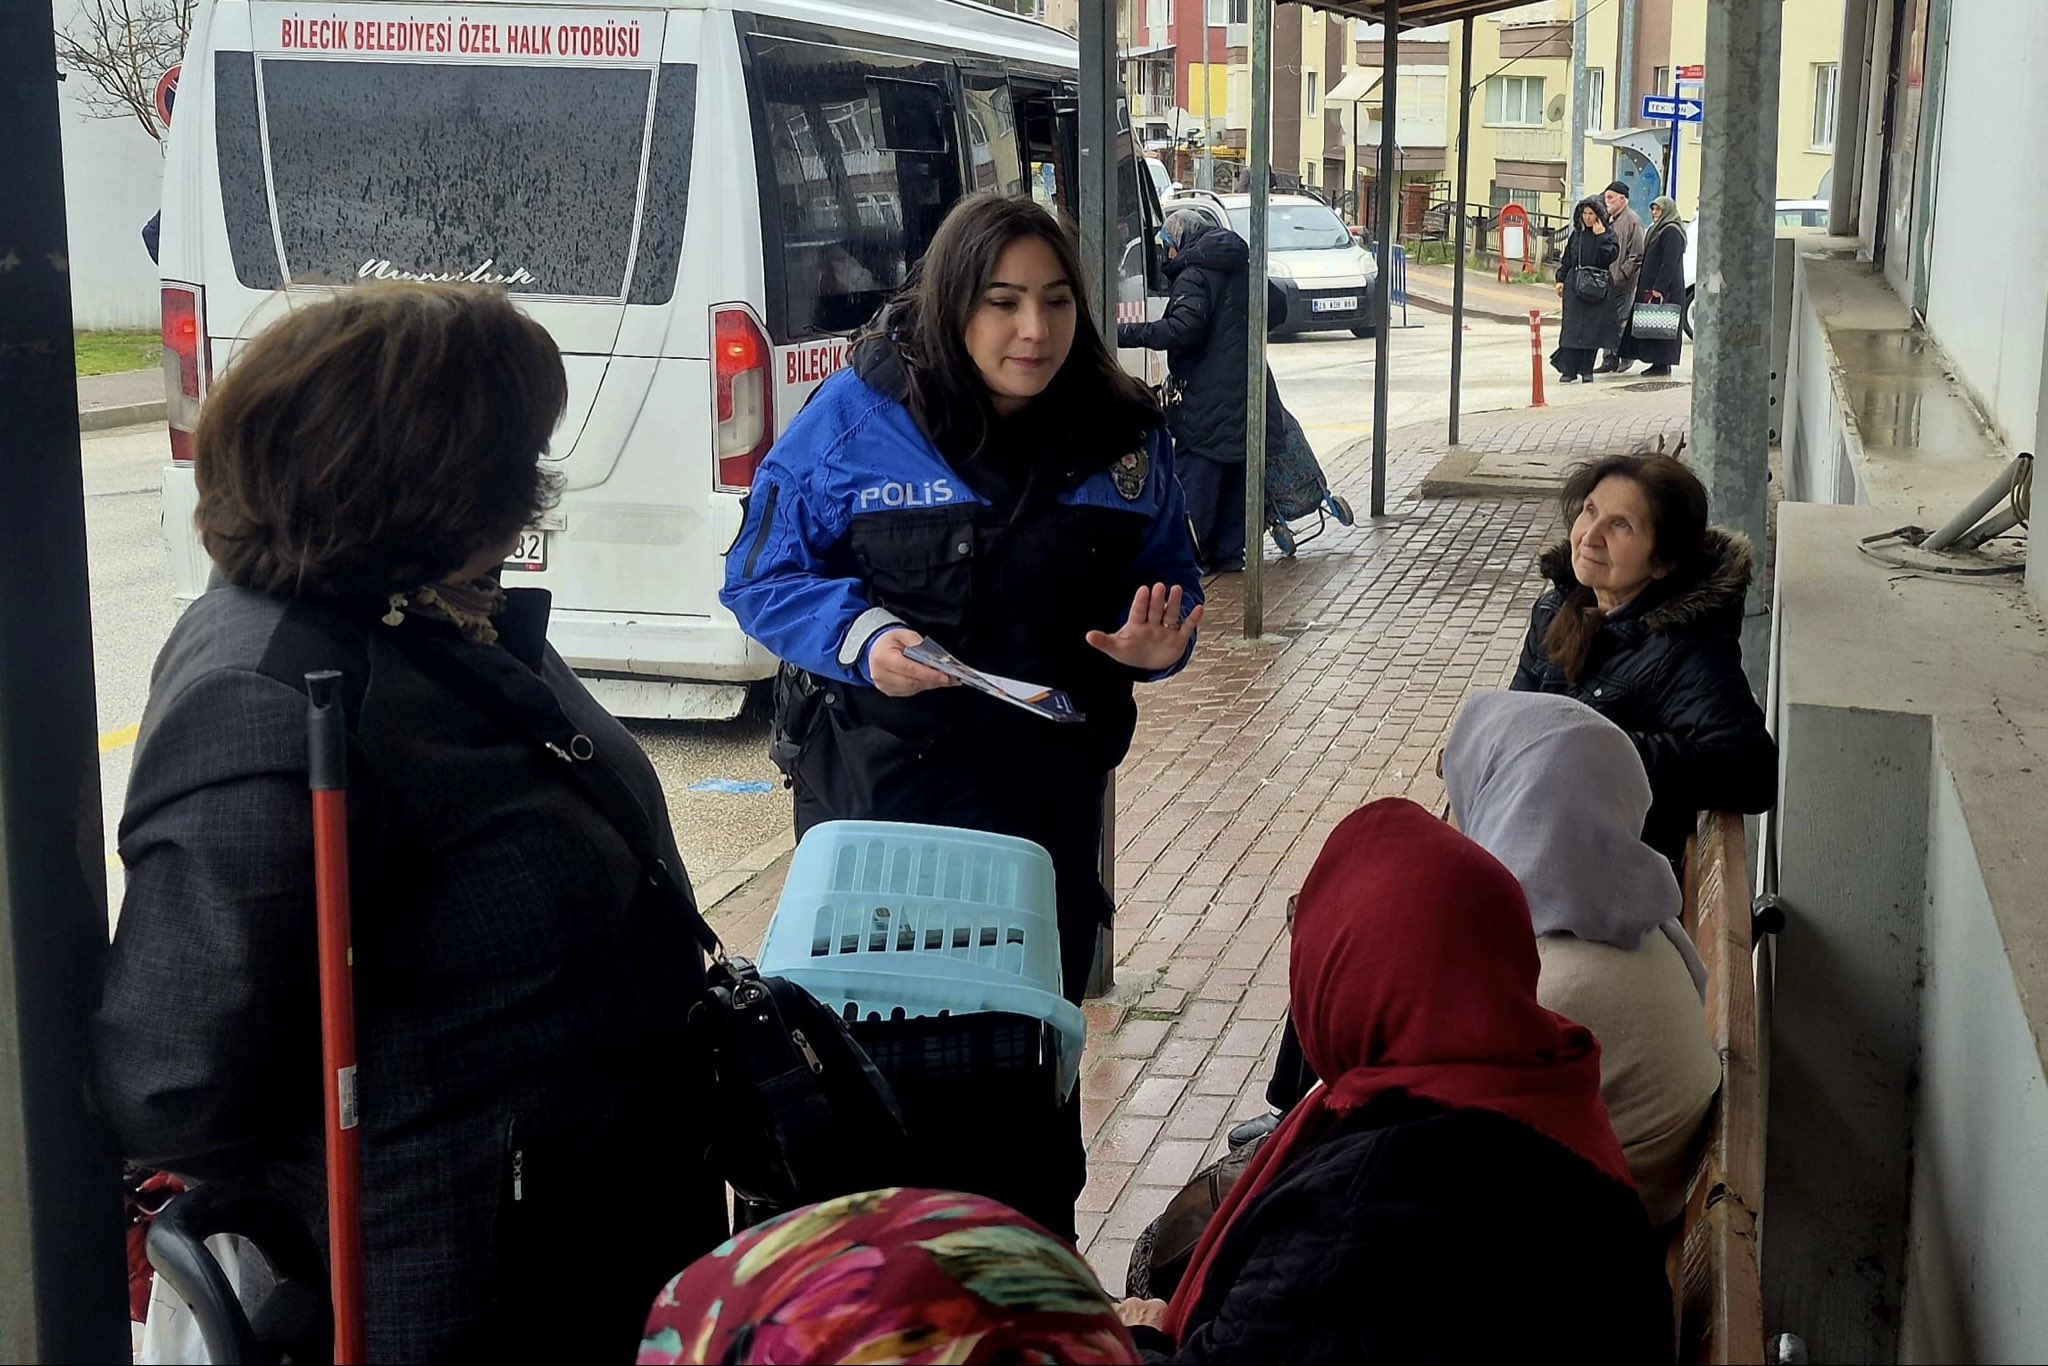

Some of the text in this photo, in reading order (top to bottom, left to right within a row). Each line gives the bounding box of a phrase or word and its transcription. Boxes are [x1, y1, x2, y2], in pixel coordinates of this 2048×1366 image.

[281, 12, 640, 57] BİLECİK BELEDİYESİ ÖZEL HALK OTOBÜSÜ
